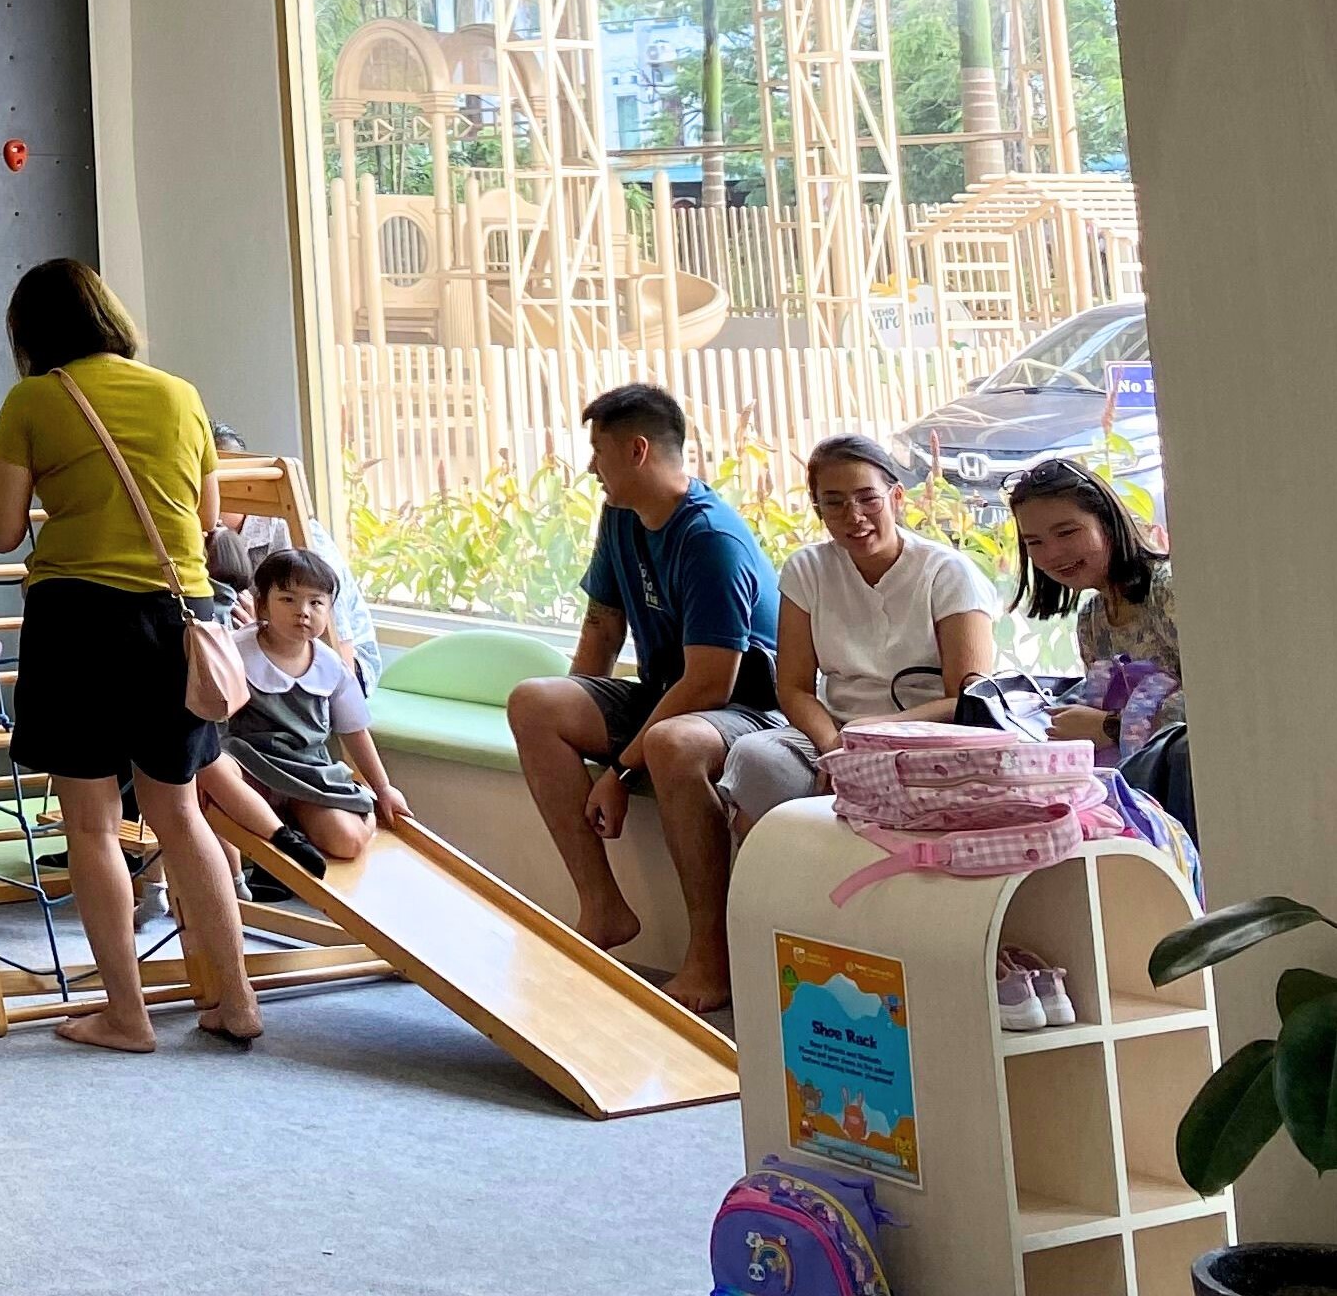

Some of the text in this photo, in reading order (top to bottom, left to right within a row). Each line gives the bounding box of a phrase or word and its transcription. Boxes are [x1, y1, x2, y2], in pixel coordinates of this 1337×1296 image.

[1117, 379, 1142, 393] No
[811, 1020, 842, 1040] Shoe
[845, 1029, 877, 1049] Rack
